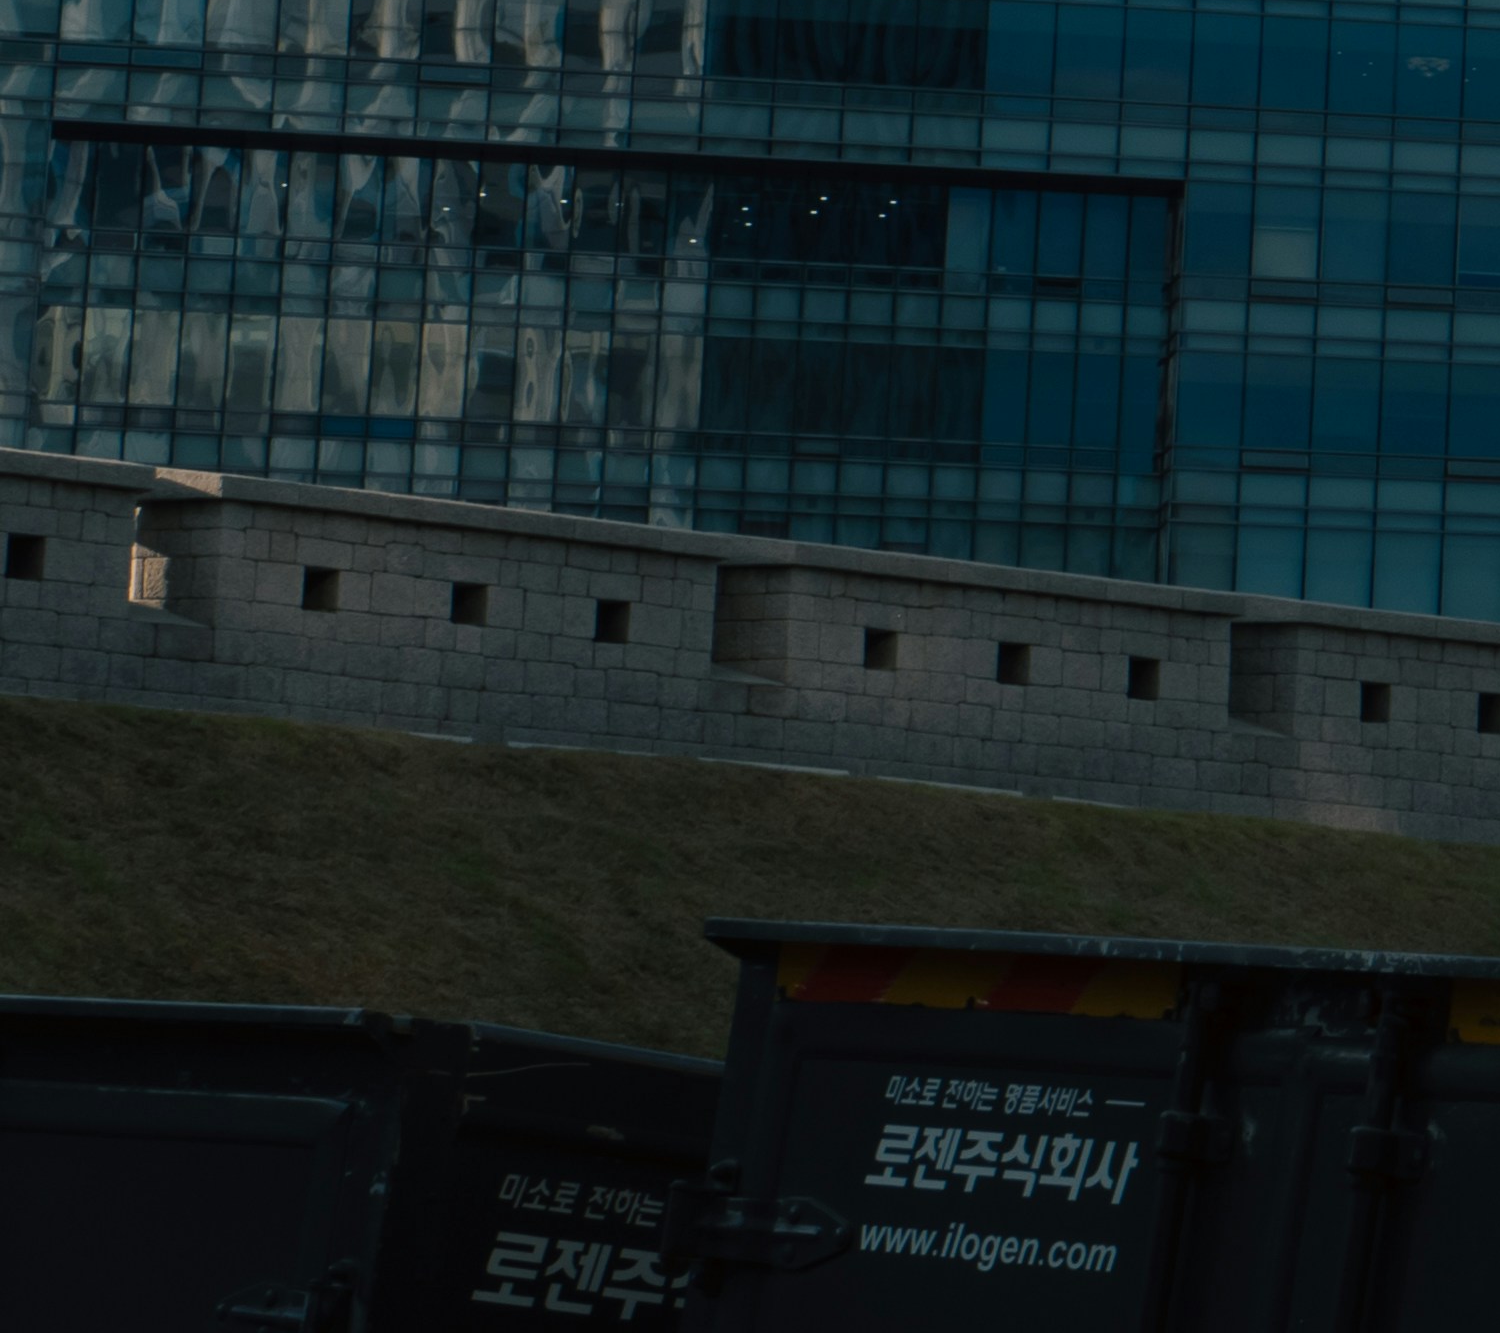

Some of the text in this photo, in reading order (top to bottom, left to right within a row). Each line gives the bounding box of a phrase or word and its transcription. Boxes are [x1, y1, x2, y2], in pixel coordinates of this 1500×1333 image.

[884, 1074, 1094, 1117] 미소로 전하는 명품서비스
[864, 1124, 1140, 1205] 로젠주식회사
[498, 1173, 664, 1228] 미소로 전하는
[859, 1222, 1120, 1272] www.ilogen.com
[470, 1230, 692, 1320] 로젠주
